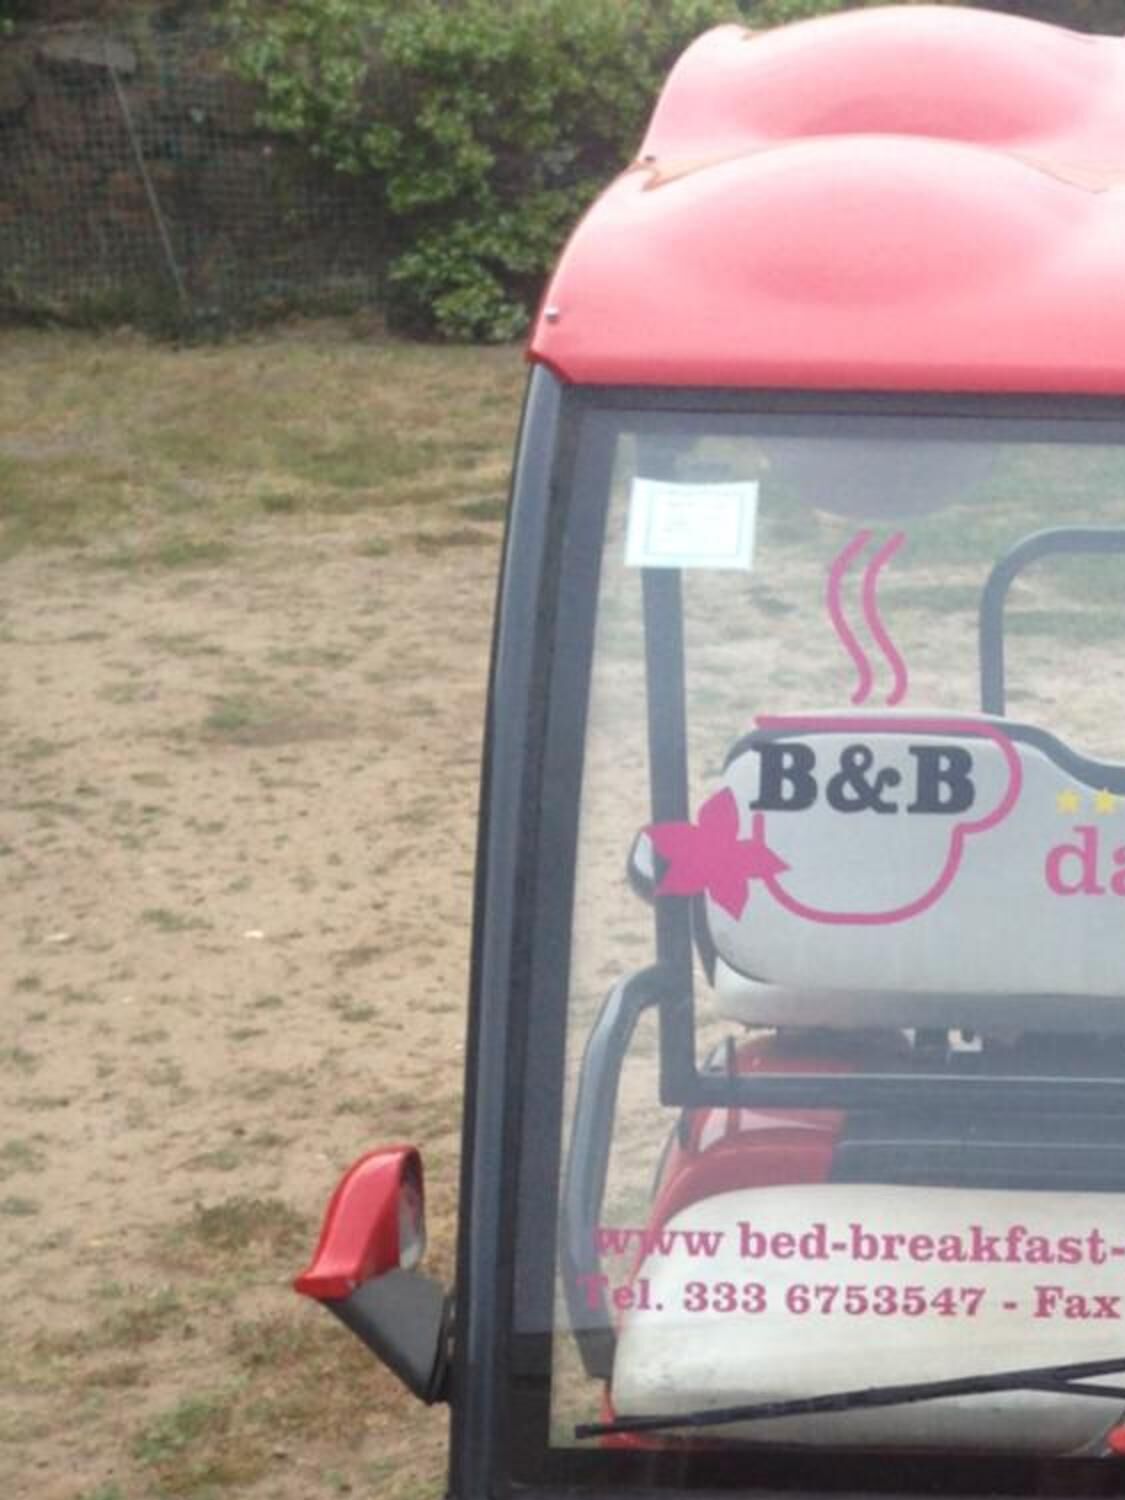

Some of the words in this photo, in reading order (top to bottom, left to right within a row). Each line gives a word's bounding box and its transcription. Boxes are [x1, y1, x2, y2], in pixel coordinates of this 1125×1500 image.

[749, 742, 977, 816] B&B
[576, 1275, 665, 1312] Tel.
[683, 1282, 768, 1313] 333
[786, 1284, 987, 1317] 6753547
[1033, 1285, 1122, 1320] Fax
